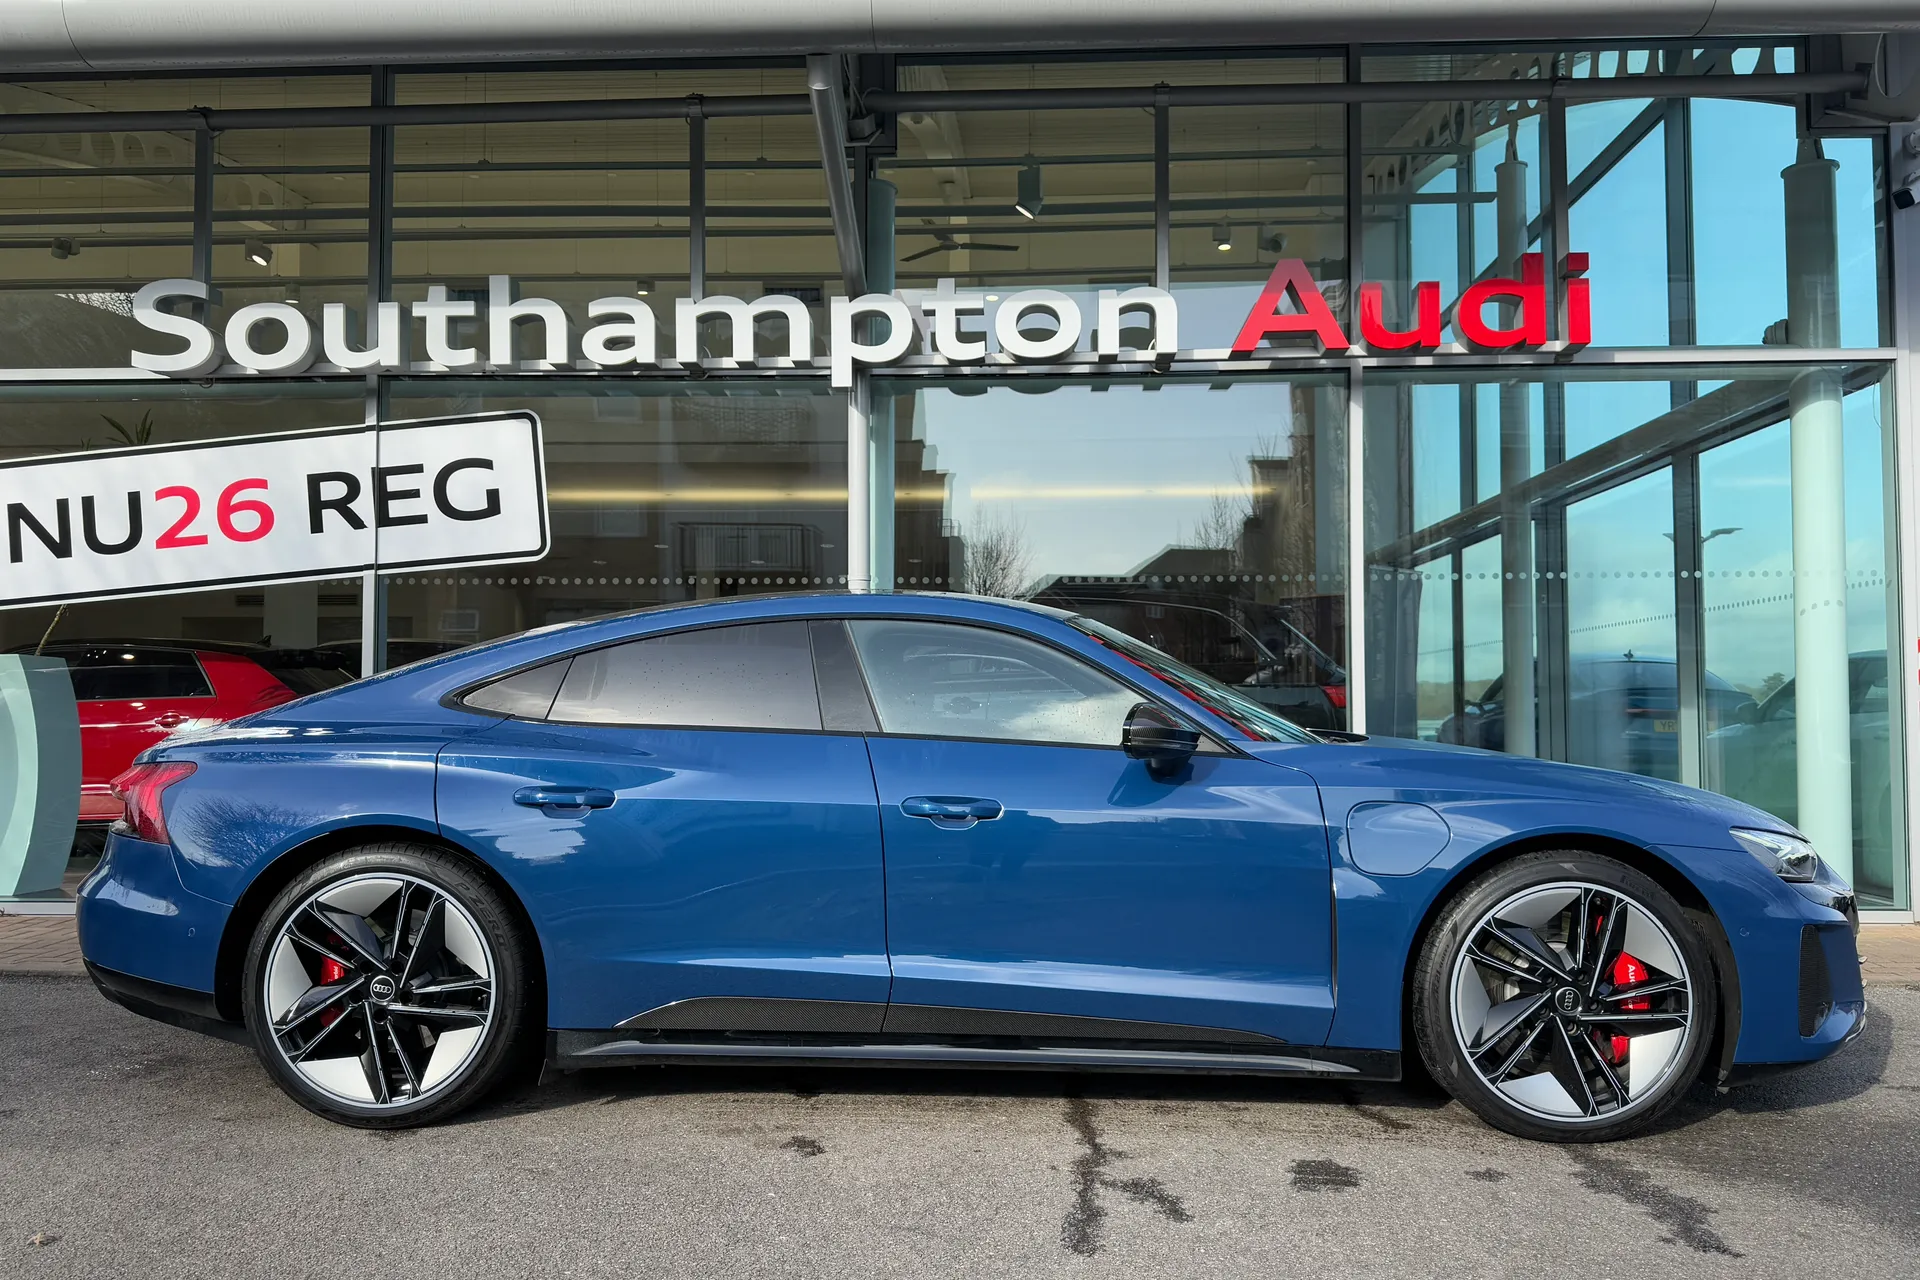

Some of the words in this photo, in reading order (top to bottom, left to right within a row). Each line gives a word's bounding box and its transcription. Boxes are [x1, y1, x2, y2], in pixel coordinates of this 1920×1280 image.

[131, 274, 1178, 388] Southampton
[1232, 252, 1592, 353] Audi
[7, 477, 276, 563] NU26
[306, 457, 502, 534] REG
